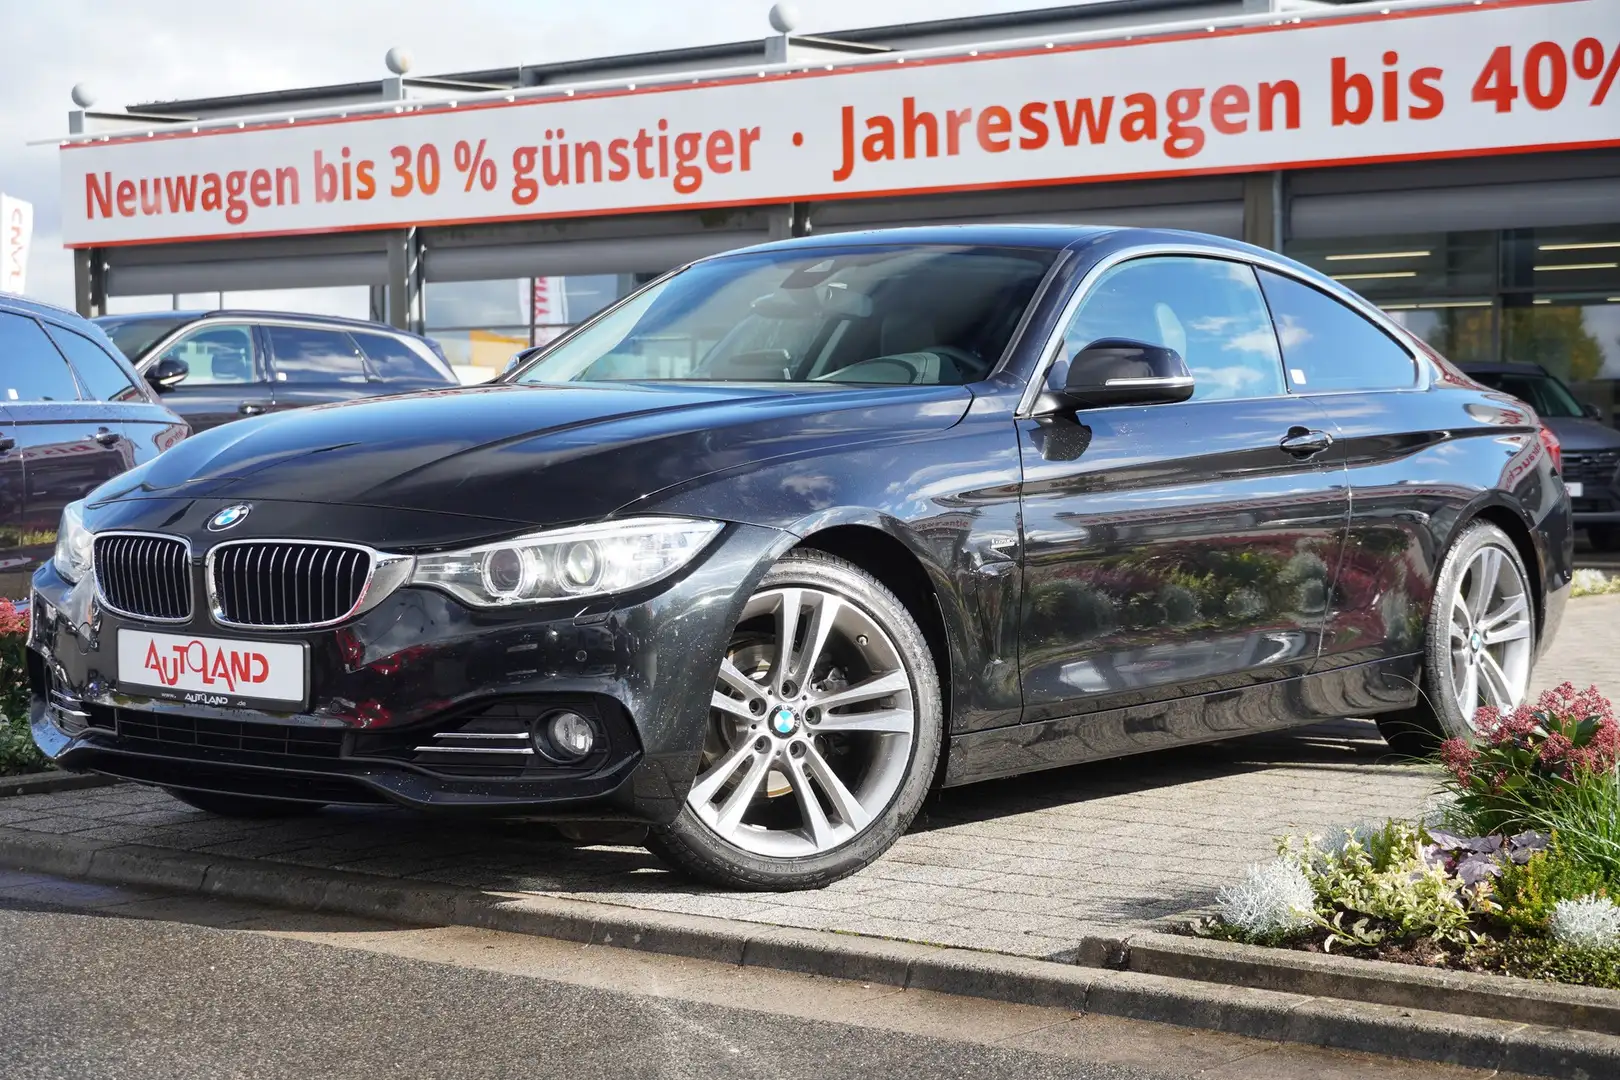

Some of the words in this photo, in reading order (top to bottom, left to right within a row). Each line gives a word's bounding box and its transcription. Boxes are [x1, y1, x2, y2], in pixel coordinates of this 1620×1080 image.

[86, 167, 299, 225] Neuwagen
[314, 146, 375, 202] bis
[390, 143, 441, 198] 30
[454, 139, 497, 193] %
[511, 118, 761, 206] günstiger
[832, 79, 1302, 183] Jahreswagen
[1330, 50, 1446, 127] bis
[1471, 36, 1620, 114] 40%
[144, 638, 270, 693] AUTOLAND
[184, 692, 229, 705] AUTOLAND
